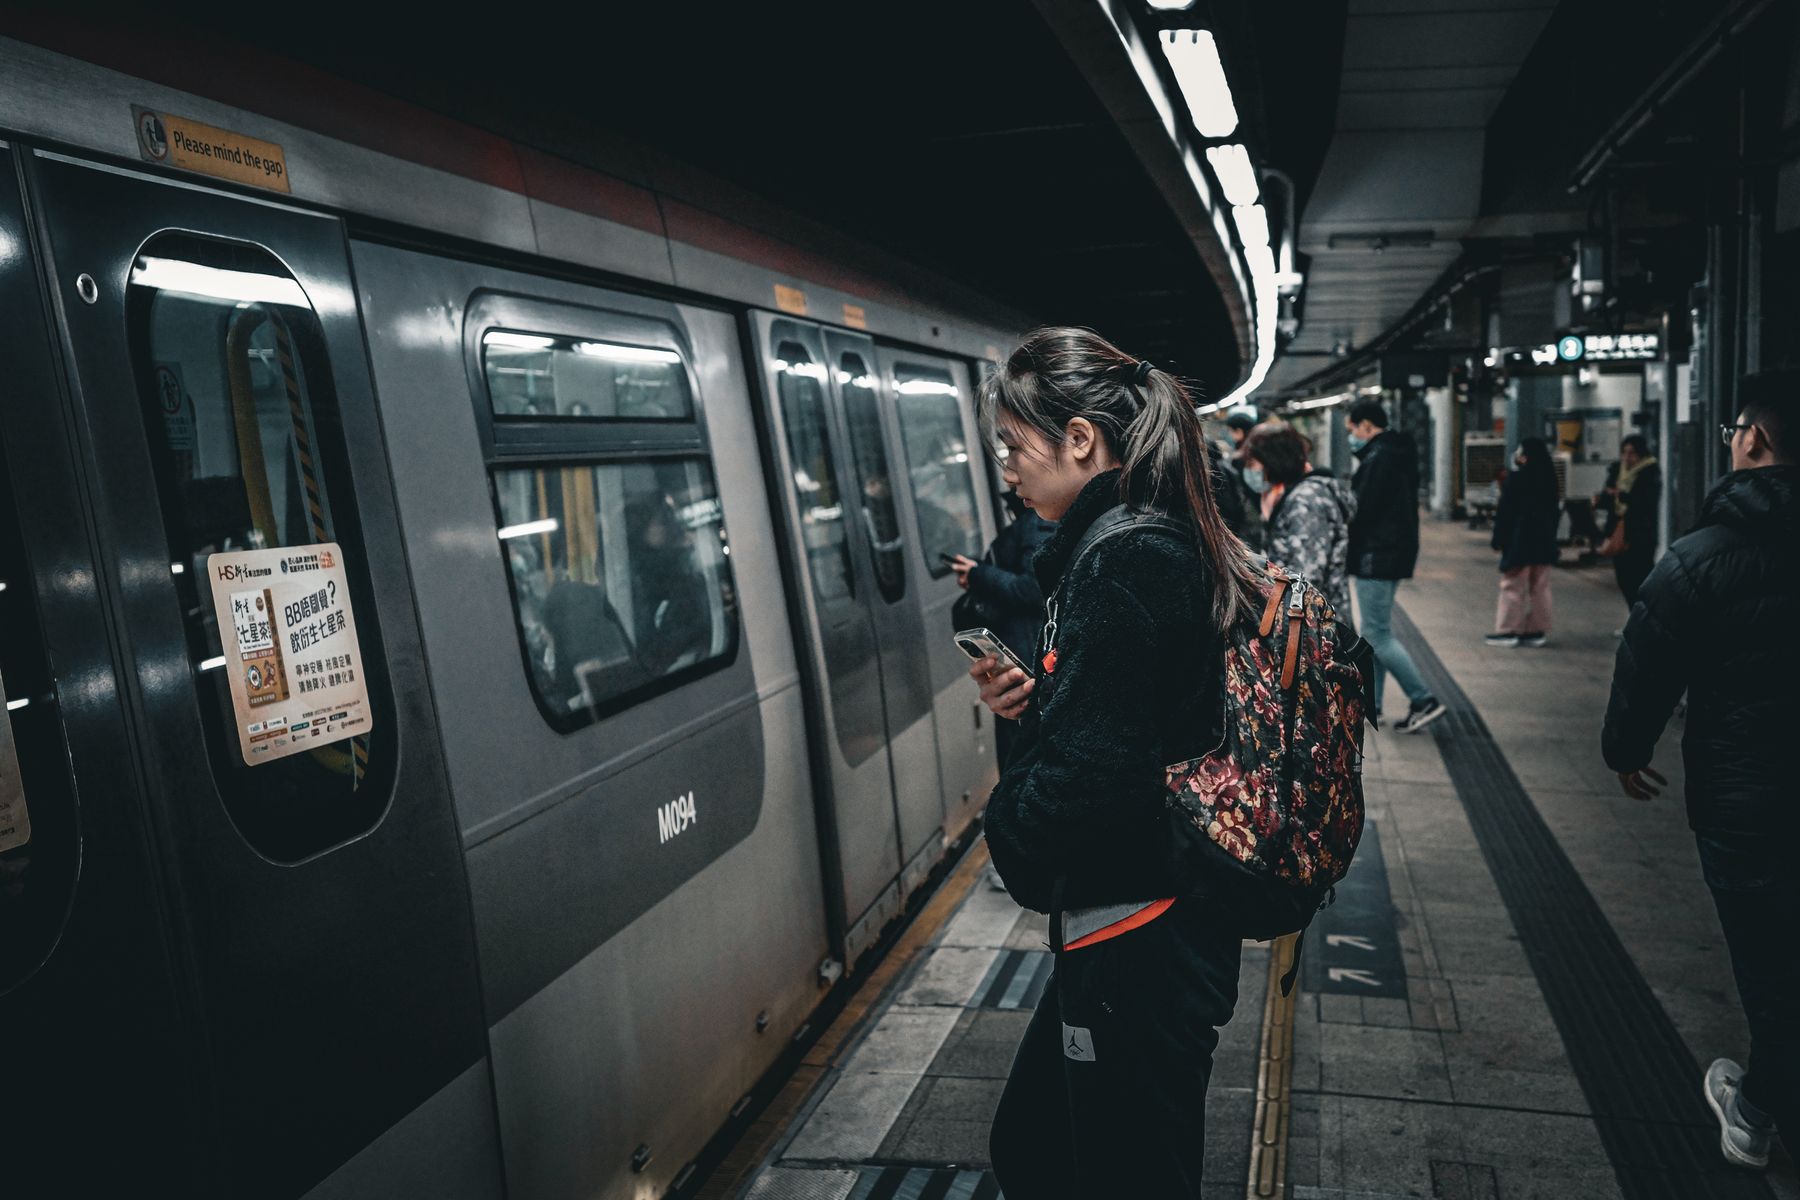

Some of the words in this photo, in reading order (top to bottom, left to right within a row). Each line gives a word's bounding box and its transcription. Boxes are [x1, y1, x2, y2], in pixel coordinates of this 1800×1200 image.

[173, 130, 211, 157] Please
[213, 144, 241, 165] mind
[243, 150, 261, 170] the
[263, 158, 283, 178] gap
[241, 621, 269, 644] 七星茶
[290, 609, 347, 654] 飲衍生七星茶
[657, 790, 697, 844] M094
